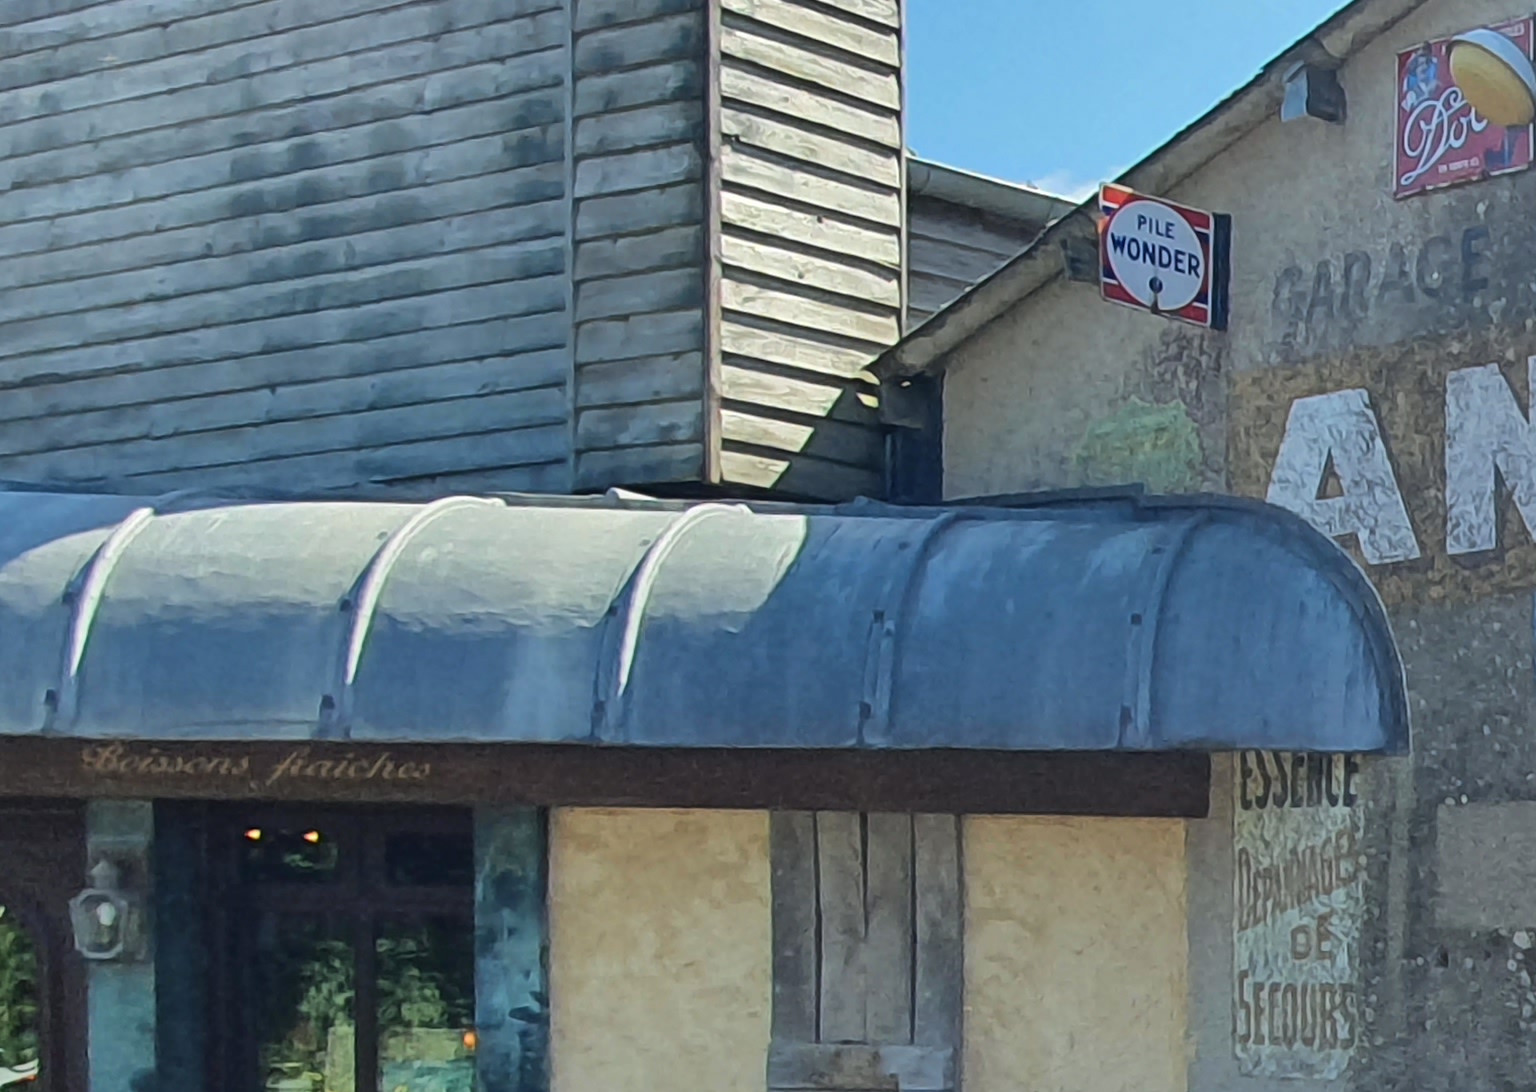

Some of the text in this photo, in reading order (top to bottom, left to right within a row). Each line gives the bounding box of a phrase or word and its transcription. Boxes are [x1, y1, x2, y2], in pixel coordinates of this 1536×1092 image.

[1137, 214, 1175, 240] PILE
[1110, 232, 1200, 279] WONDER
[81, 741, 249, 776] Boissons
[1240, 750, 1360, 811] ESSENCE
[1291, 911, 1333, 961] DE
[1238, 968, 1358, 1050] SECOURS
